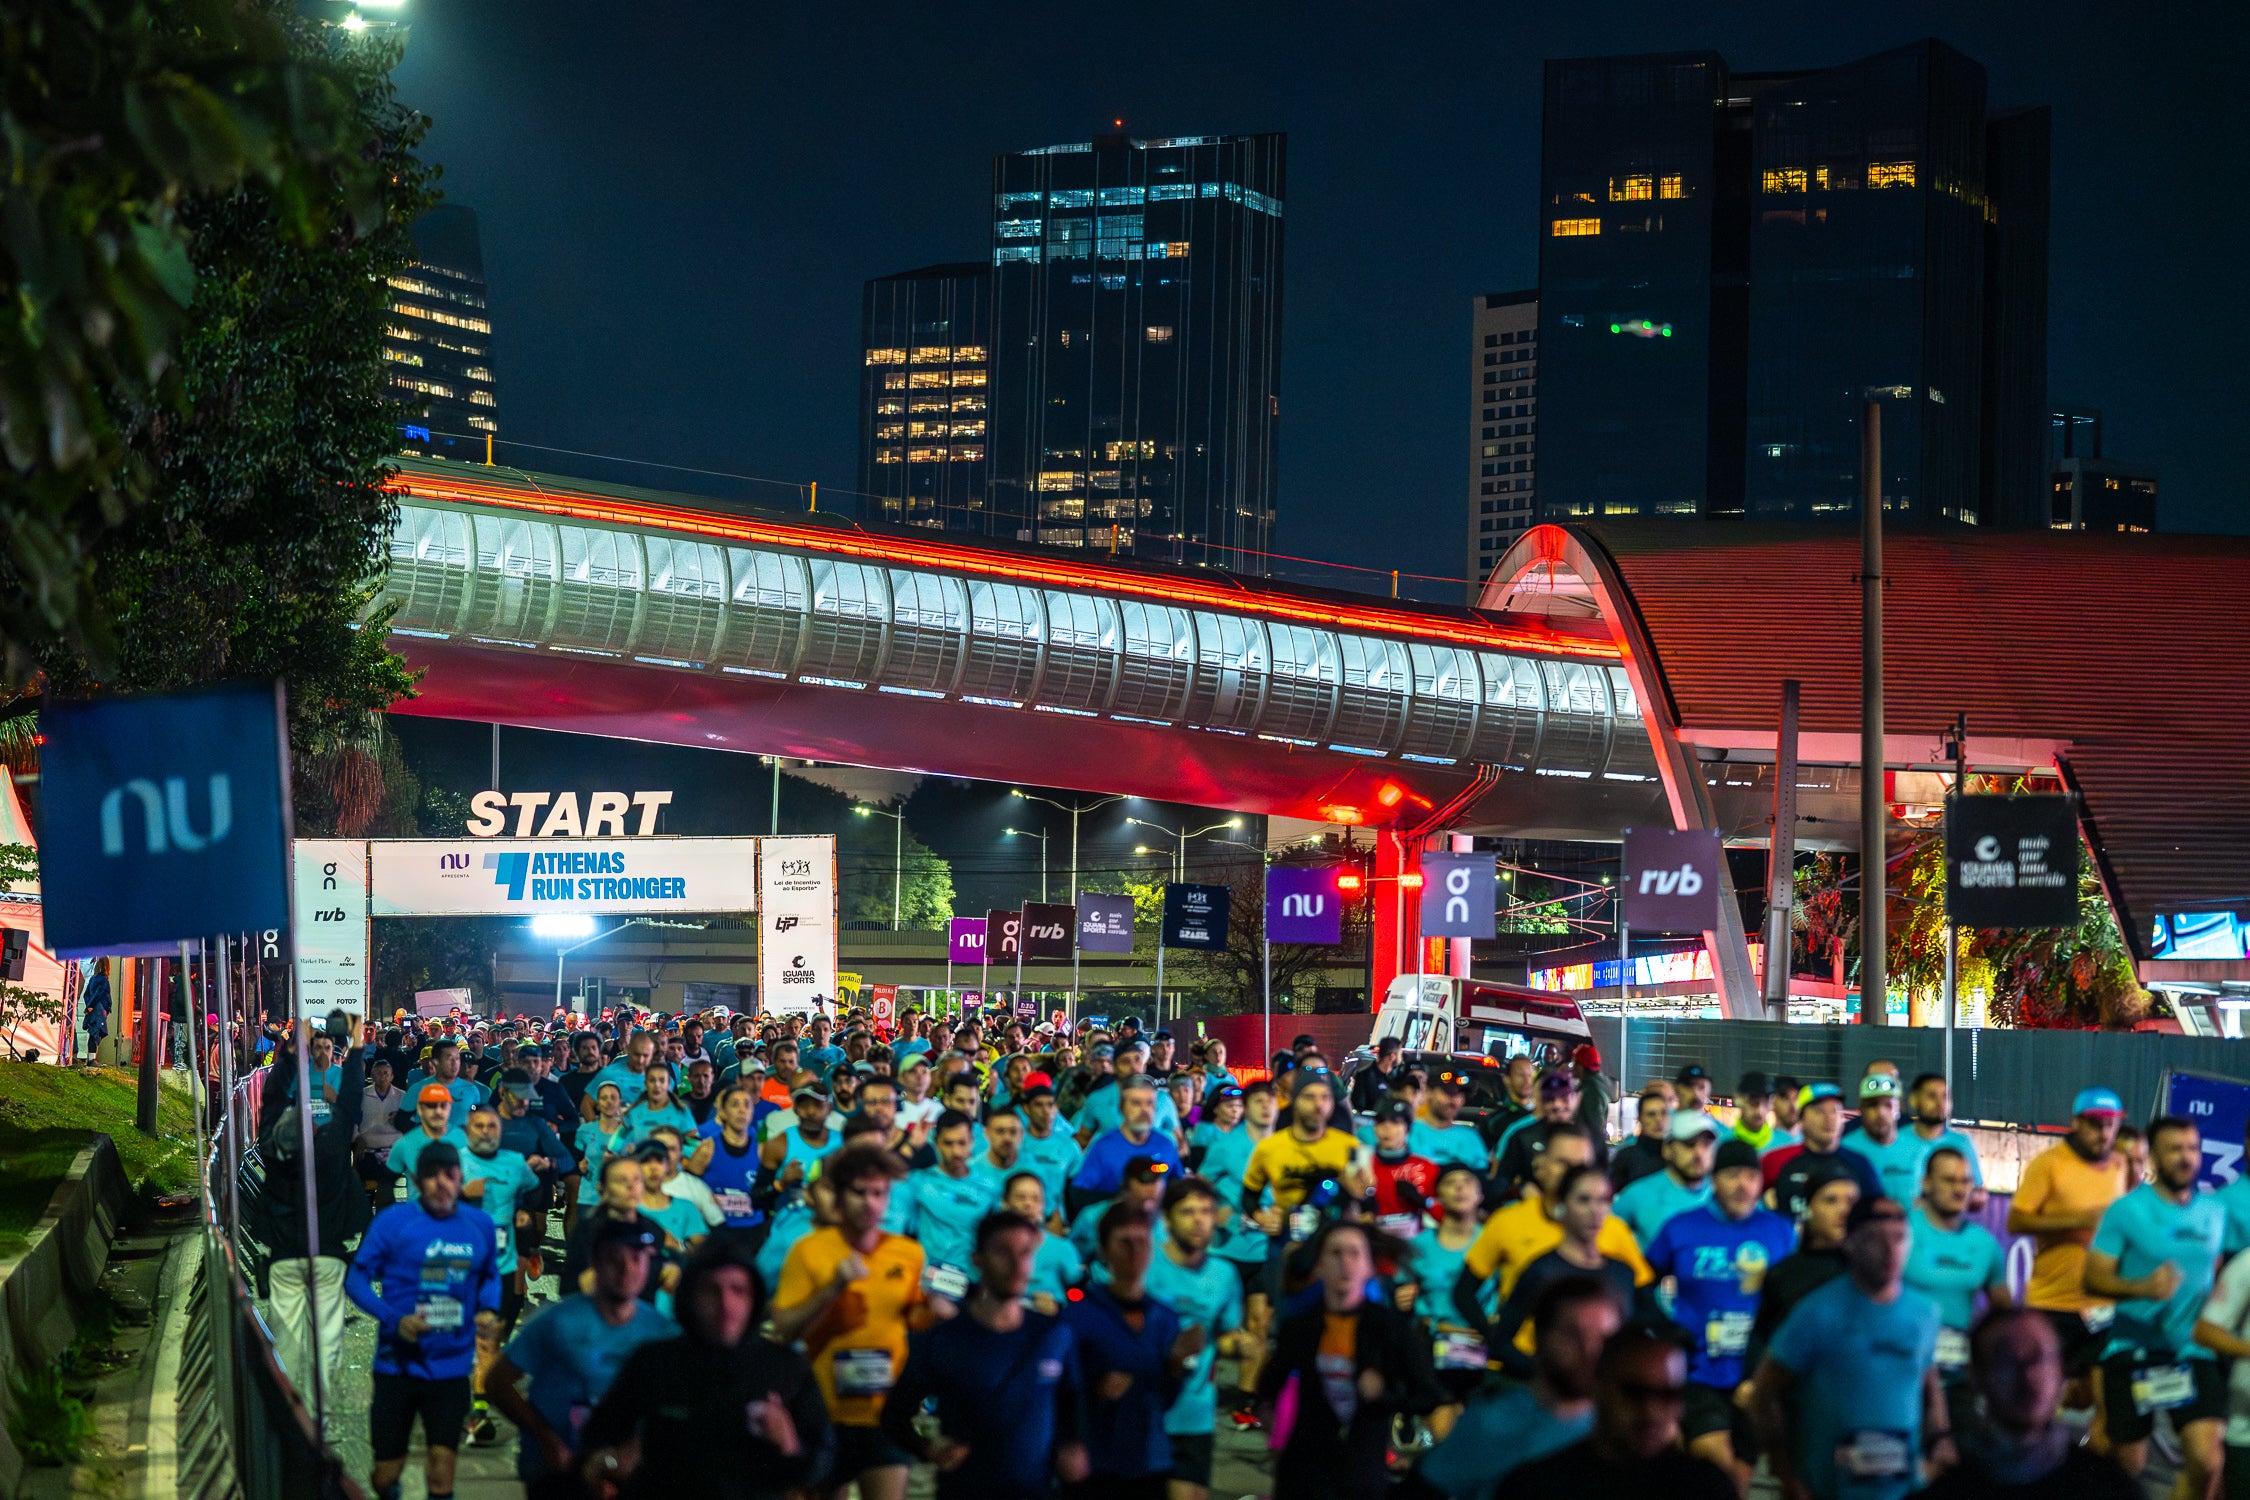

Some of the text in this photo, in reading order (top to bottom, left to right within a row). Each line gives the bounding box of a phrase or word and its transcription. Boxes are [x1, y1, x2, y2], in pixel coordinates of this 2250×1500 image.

[101, 772, 233, 858] nu
[466, 790, 673, 838] START
[440, 853, 470, 870] nu
[531, 851, 625, 874] ATHENAS
[532, 877, 686, 900] RUN STRONGER
[1639, 863, 1703, 896] rvb
[314, 907, 346, 922] rvb
[1282, 893, 1324, 917] nu
[959, 933, 984, 948] nu
[1029, 922, 1065, 940] rvb
[878, 1001, 887, 1014] B
[2189, 1100, 2214, 1116] nu
